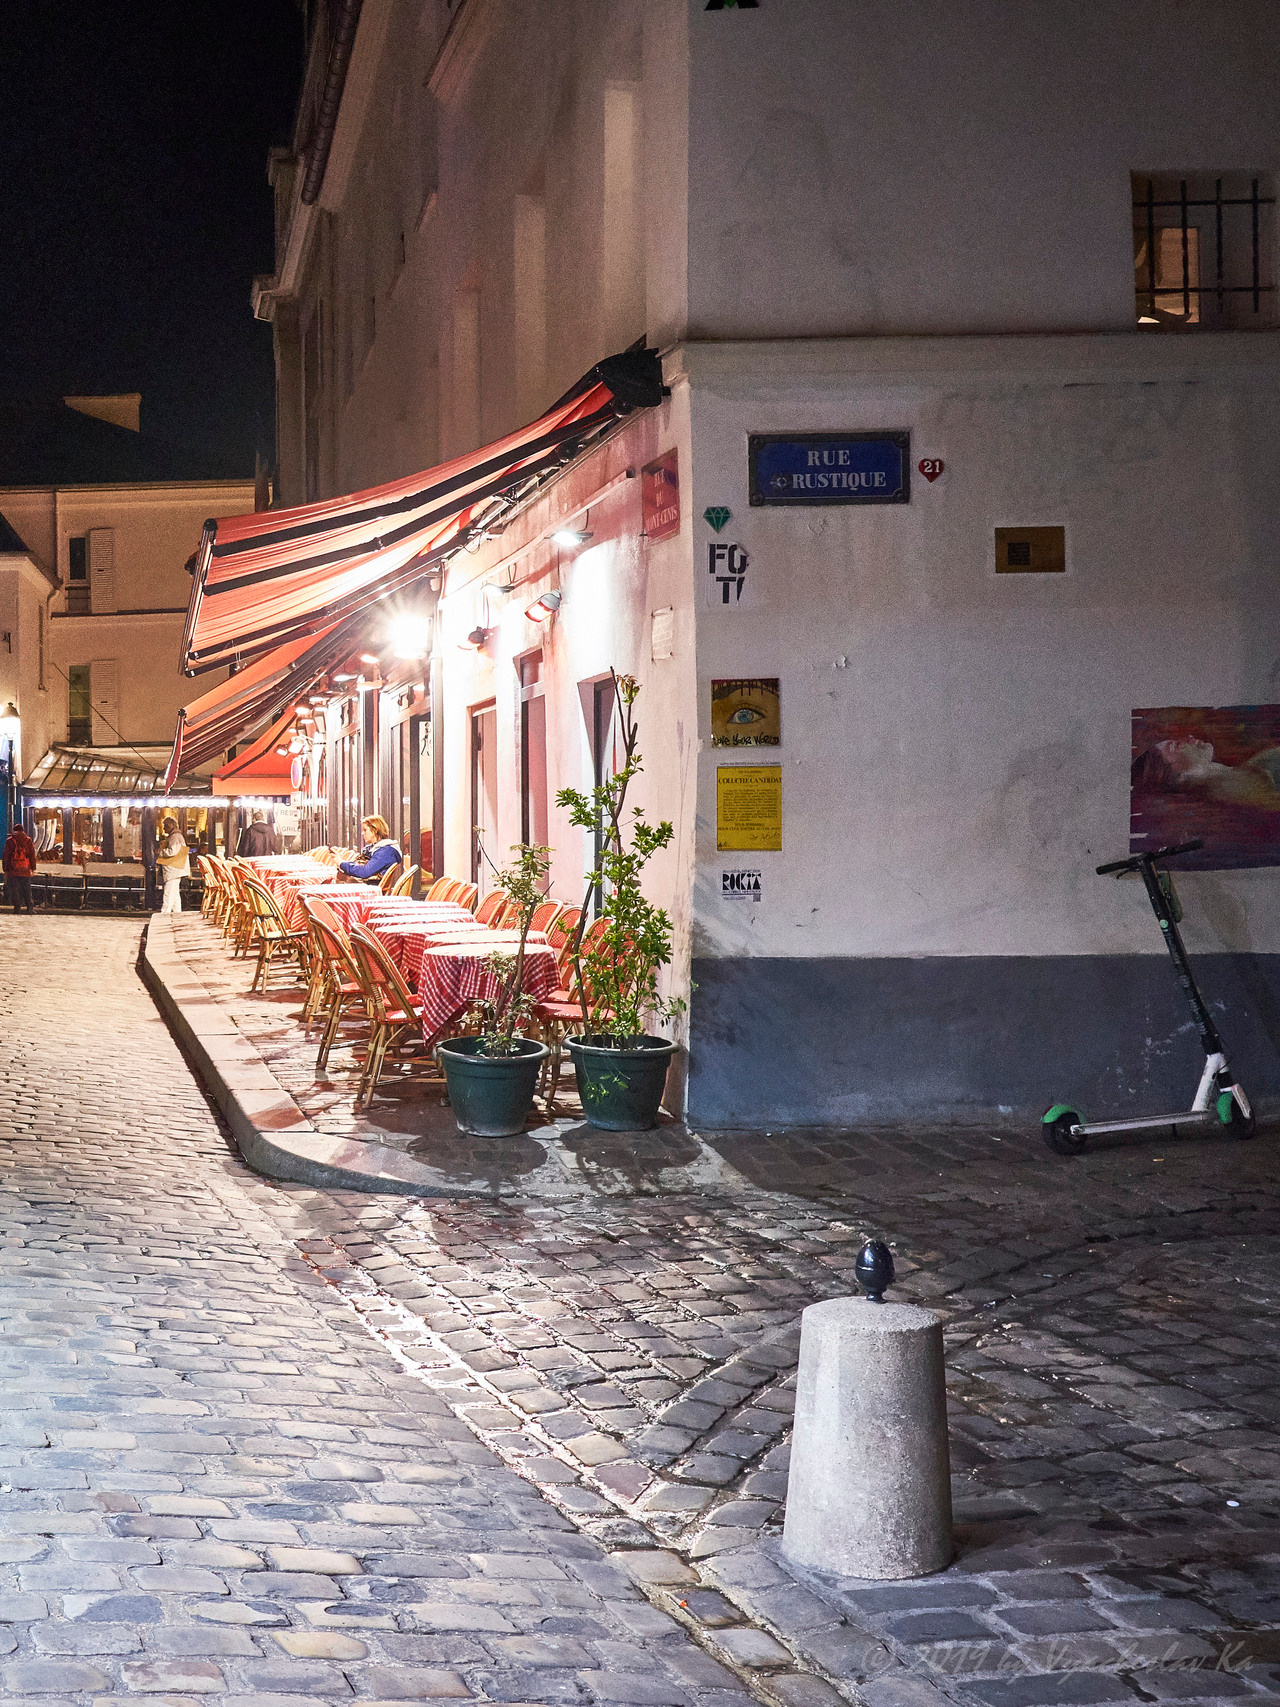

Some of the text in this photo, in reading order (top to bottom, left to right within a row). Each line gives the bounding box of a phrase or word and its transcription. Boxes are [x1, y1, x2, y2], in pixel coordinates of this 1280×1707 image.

[807, 449, 851, 467] RUE
[923, 460, 942, 473] 21
[792, 471, 887, 491] RUSTIQUE
